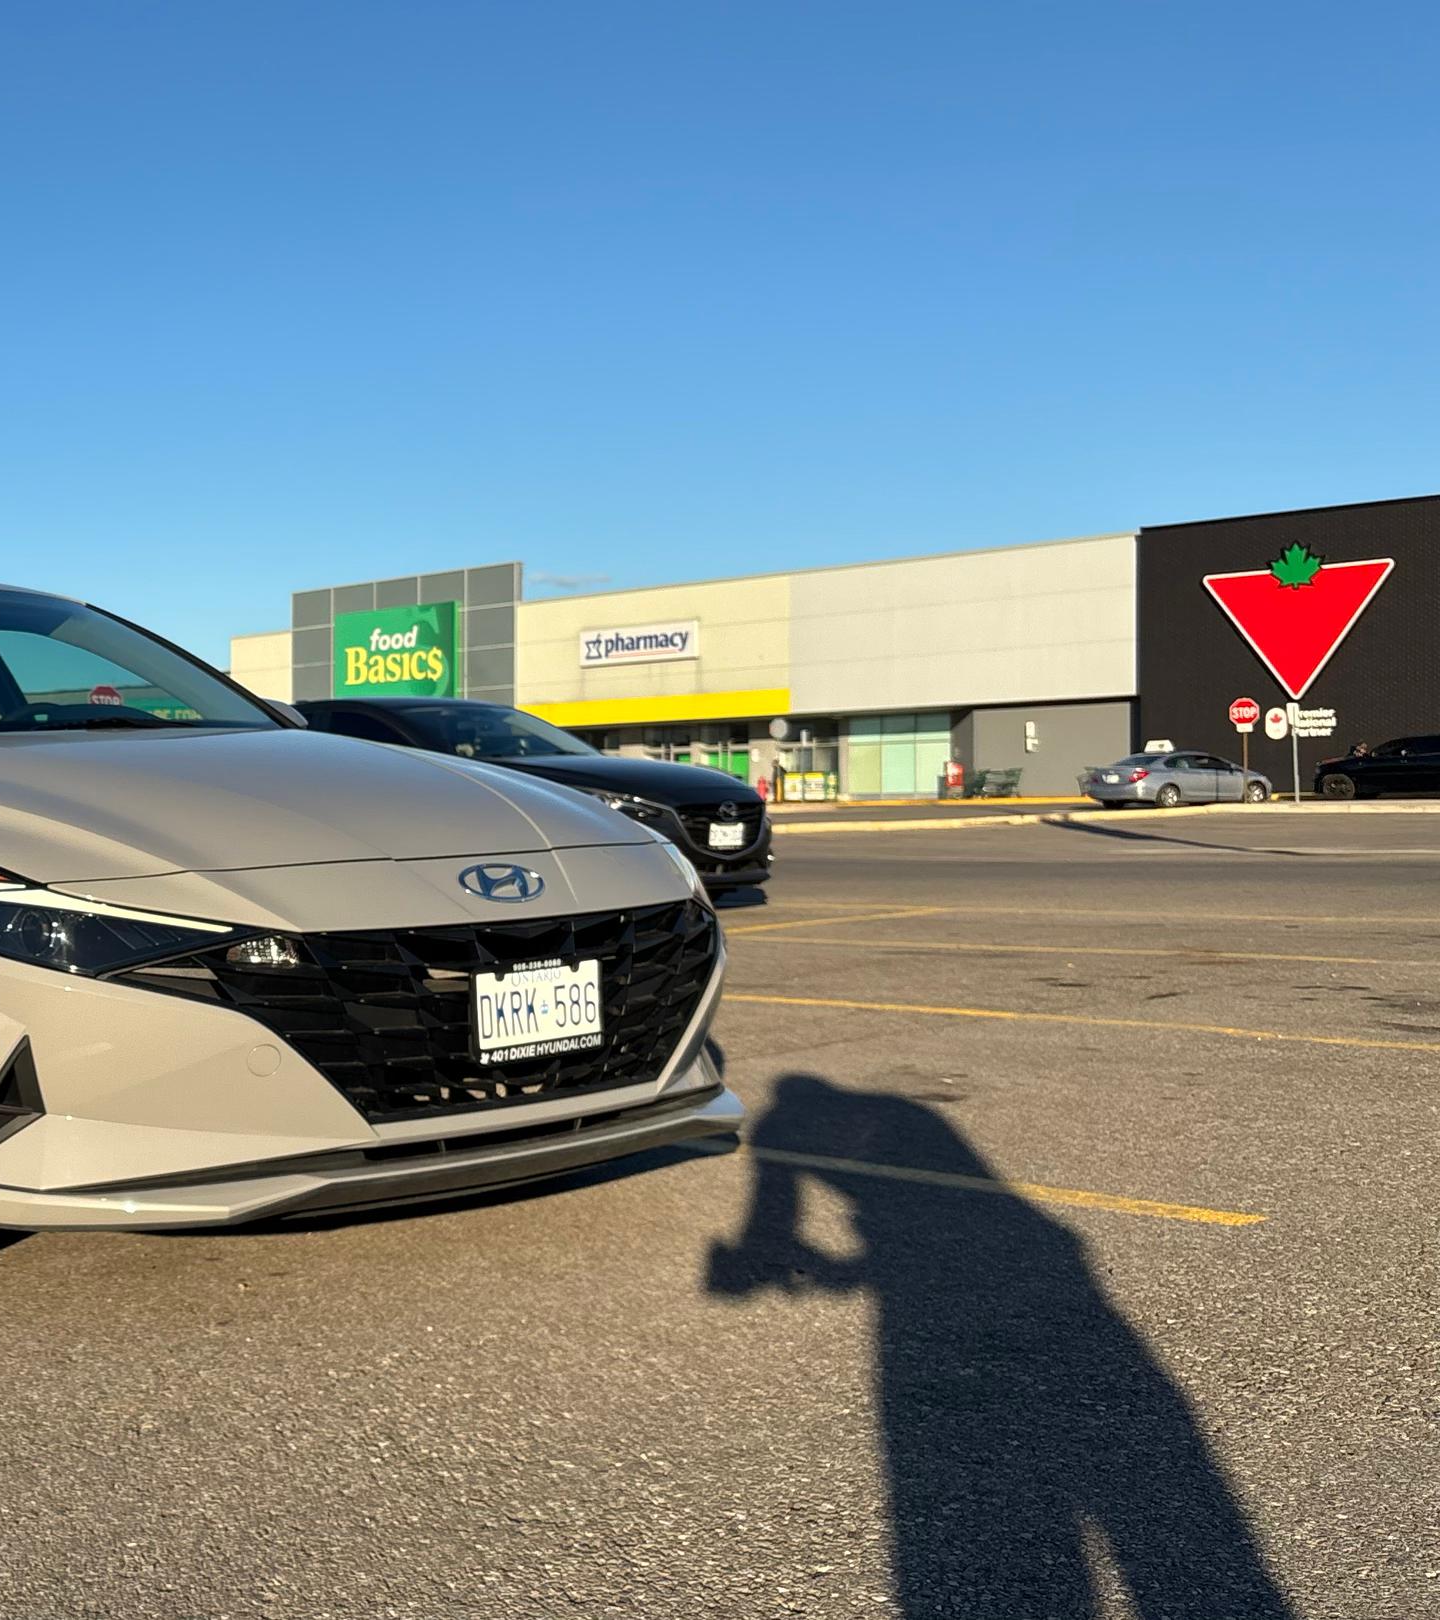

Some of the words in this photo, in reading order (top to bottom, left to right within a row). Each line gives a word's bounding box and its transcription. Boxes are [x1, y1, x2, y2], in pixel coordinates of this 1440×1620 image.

[370, 625, 418, 652] food
[604, 631, 688, 658] pharmacy
[1231, 706, 1258, 719] STOP
[480, 986, 539, 1040] DKRK
[554, 981, 596, 1028] 586
